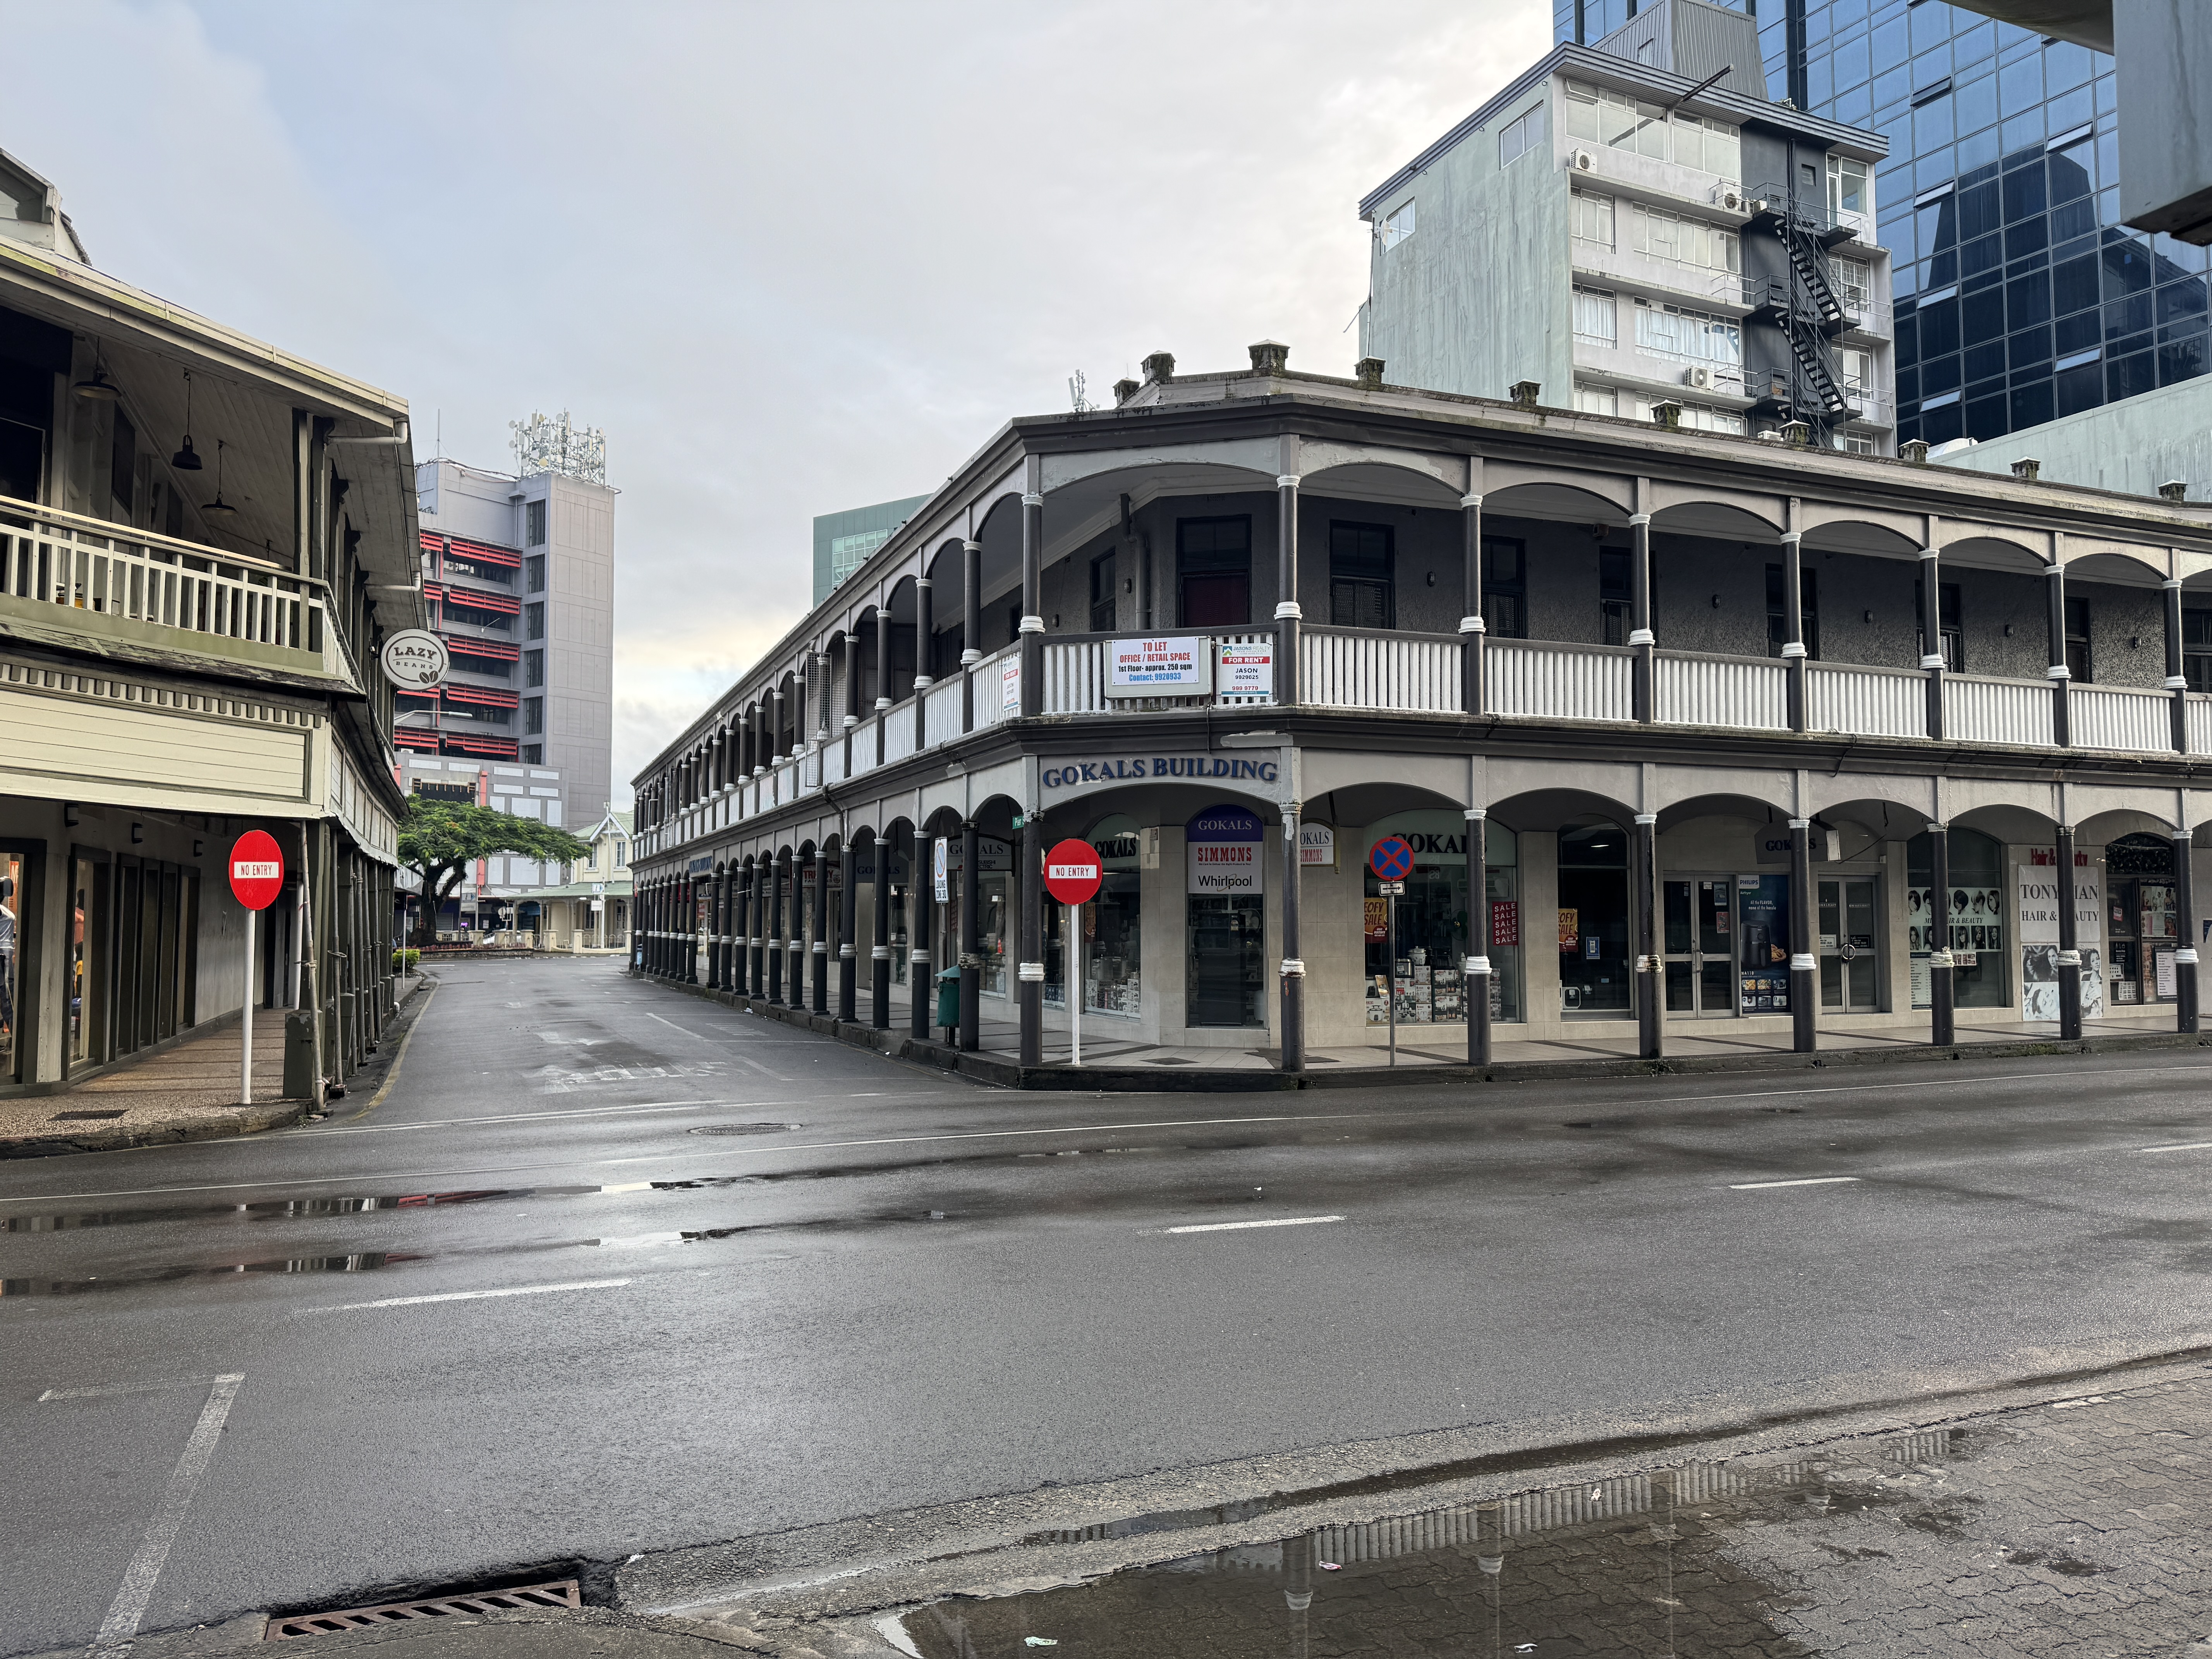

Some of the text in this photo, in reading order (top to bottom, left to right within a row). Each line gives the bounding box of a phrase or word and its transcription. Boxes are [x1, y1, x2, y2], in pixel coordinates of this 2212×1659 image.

[1143, 642, 1167, 651] TO LET
[394, 647, 437, 659] LAZY
[1120, 653, 1190, 663] OFFICE / RETAIL SPACE
[1043, 757, 1277, 788] GOKALS BUILDING
[1198, 820, 1252, 830] GOKALS
[1300, 831, 1329, 845] OKALS
[950, 844, 1003, 854] GALS
[1765, 838, 1817, 851] GOKS
[1198, 847, 1252, 862] SIMMONS
[2031, 848, 2048, 866] Hair
[2049, 848, 2056, 866] &
[241, 865, 272, 876] NO ENTRY
[857, 866, 900, 874] GOLS
[1056, 867, 1089, 877] NO ENTRY
[936, 880, 946, 889] LOADING
[1198, 875, 1252, 890] Whirlpool
[942, 890, 946, 898] 30
[1364, 902, 1384, 913] EOFY
[1494, 903, 1516, 912] SALE
[1365, 914, 1382, 925] SALE
[1495, 911, 1516, 920] SALE
[2022, 910, 2047, 921] HAIR
[2049, 910, 2057, 921] &
[1495, 919, 1516, 928] SALE
[1496, 927, 1517, 936] SALE
[1496, 935, 1517, 944] SALE
